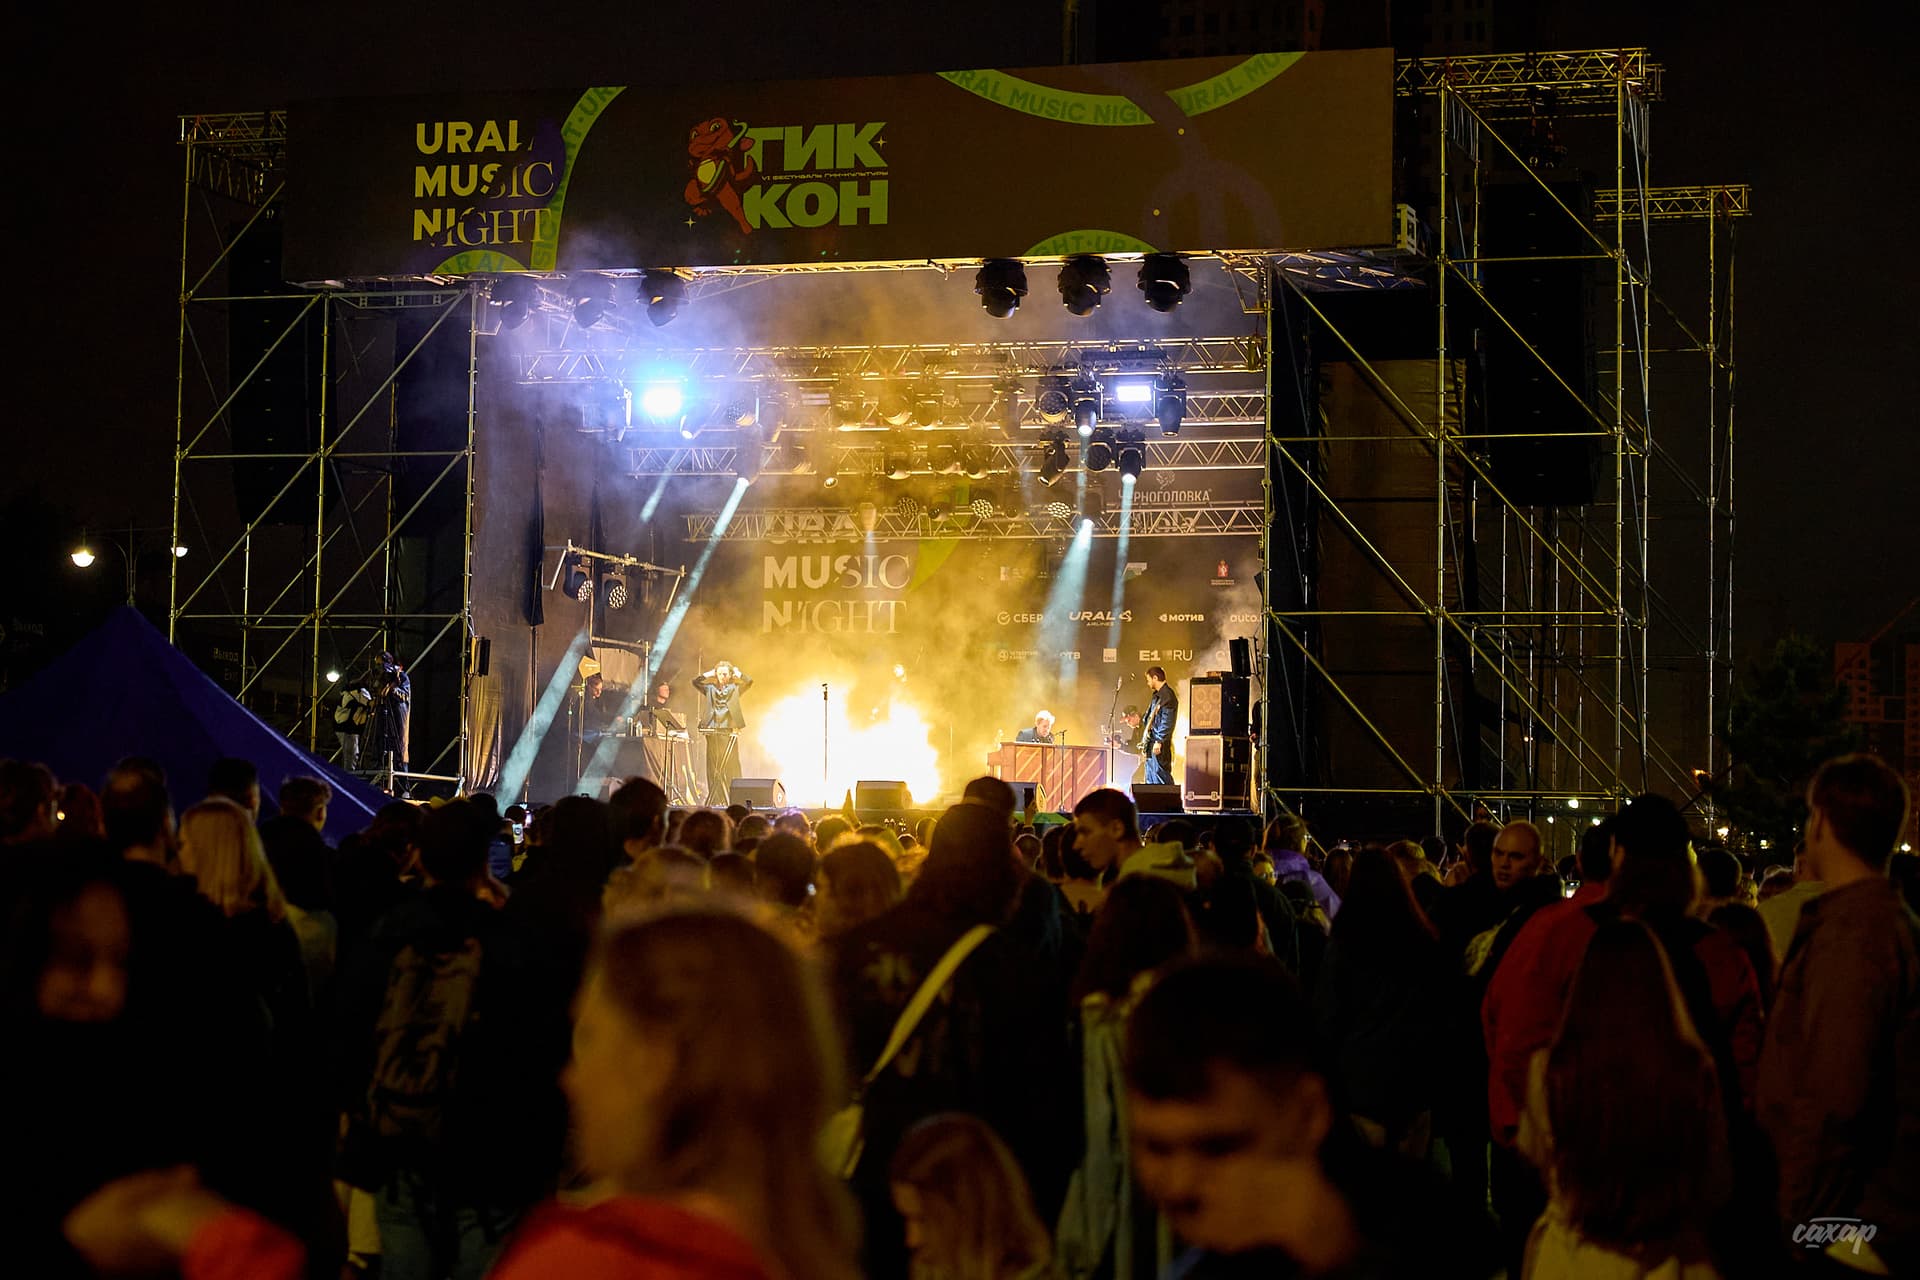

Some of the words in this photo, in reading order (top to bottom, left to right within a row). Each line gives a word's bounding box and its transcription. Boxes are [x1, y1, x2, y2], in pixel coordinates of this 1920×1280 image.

[1008, 87, 1086, 122] MUSIC
[415, 119, 535, 155] URAL
[414, 160, 554, 199] MUSIC
[743, 179, 889, 230] КОН
[412, 206, 552, 248] NIGHT
[764, 554, 910, 590] MUSIC
[762, 600, 908, 634] NIGHT
[1013, 613, 1044, 624] СБЕР
[1068, 611, 1117, 622] URAL
[1139, 650, 1161, 662] E1
